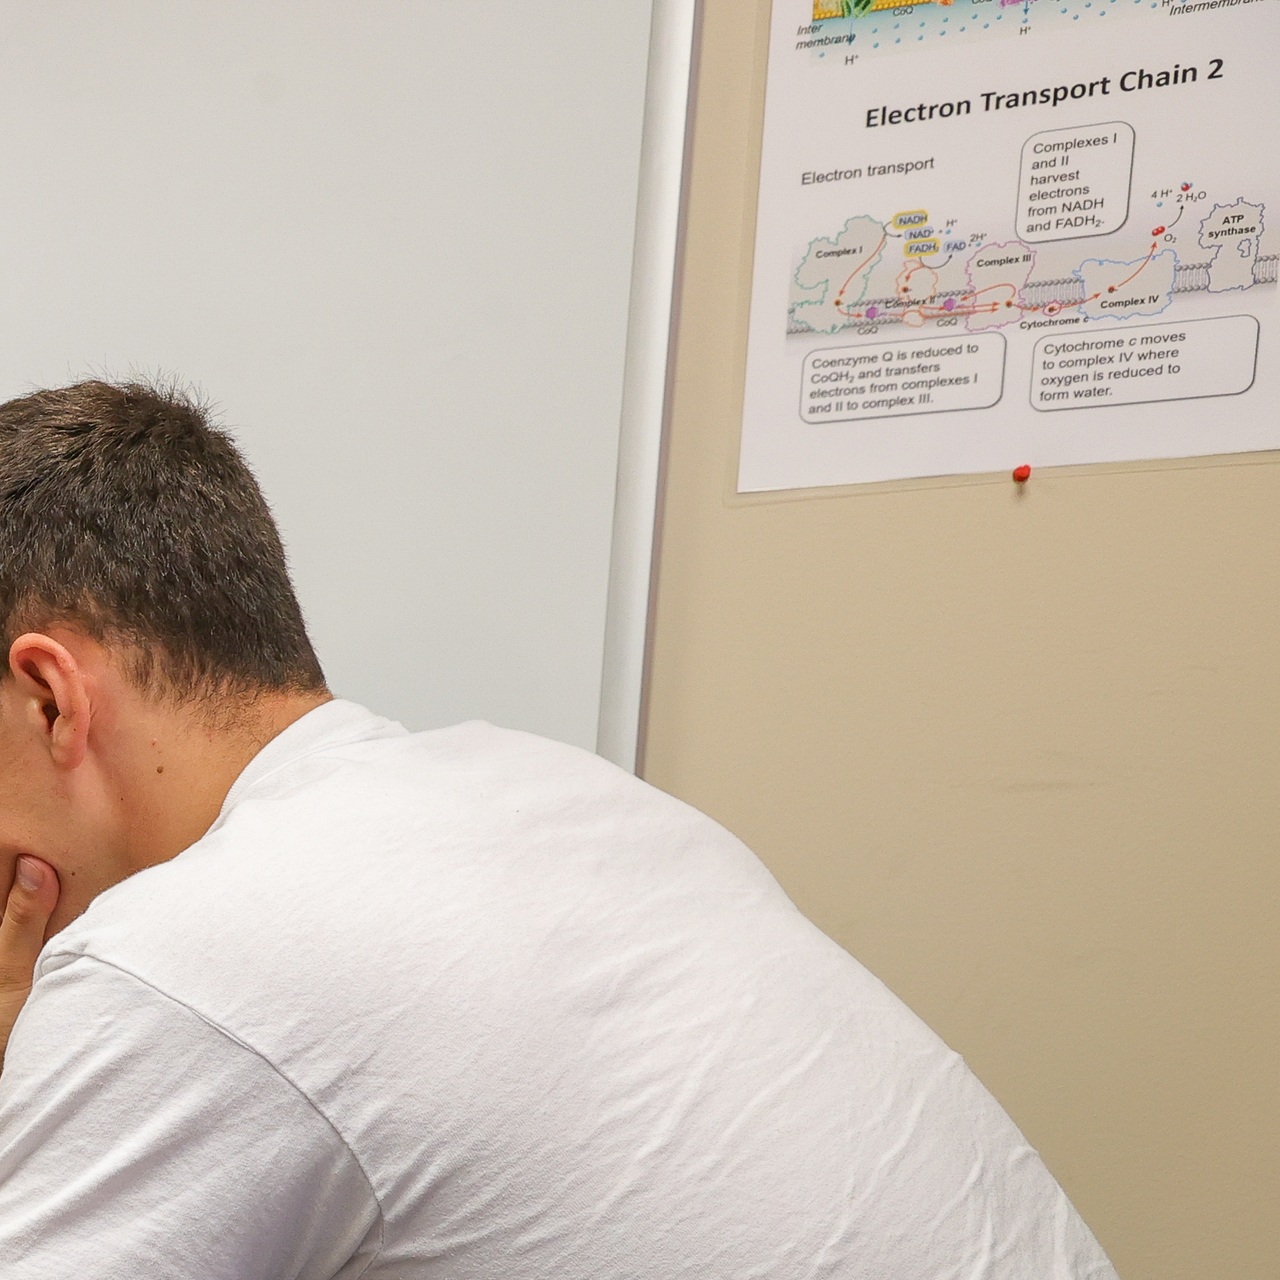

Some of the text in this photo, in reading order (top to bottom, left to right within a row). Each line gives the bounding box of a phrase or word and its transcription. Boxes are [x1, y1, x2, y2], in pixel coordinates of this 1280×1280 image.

[796, 24, 823, 36] Inter
[865, 58, 1224, 128] Electron Transport Chain 2
[1033, 132, 1118, 154] Complexes I
[1031, 156, 1069, 170] and II
[801, 157, 935, 186] Electron transport
[1030, 171, 1080, 186] harvest
[1029, 185, 1090, 202] electrons
[1151, 190, 1158, 199] 4
[1027, 198, 1104, 218] from NADH
[899, 214, 928, 226] NADH
[1026, 221, 1052, 233] and
[1222, 215, 1244, 226] ATP
[1208, 225, 1256, 240] synthase
[816, 248, 855, 259] Complex
[976, 256, 1020, 268] Complex
[1100, 294, 1160, 309] Complex IV
[1019, 315, 1081, 330] Cytochrome
[1043, 332, 1186, 357] Cytochrome c moves
[811, 344, 979, 370] Coenzyme Q is reduced to
[1042, 349, 1179, 370] to complex IV where
[857, 368, 881, 379] and
[885, 363, 940, 377] transfers
[1041, 364, 1181, 388] oxygen is reduced to
[809, 385, 865, 399] electrons
[869, 381, 898, 393] from
[901, 376, 970, 392] complexes
[1040, 386, 1113, 401] form water.
[808, 403, 831, 414] and
[836, 401, 843, 411] II
[846, 399, 858, 410] to
[861, 396, 914, 411] complex
